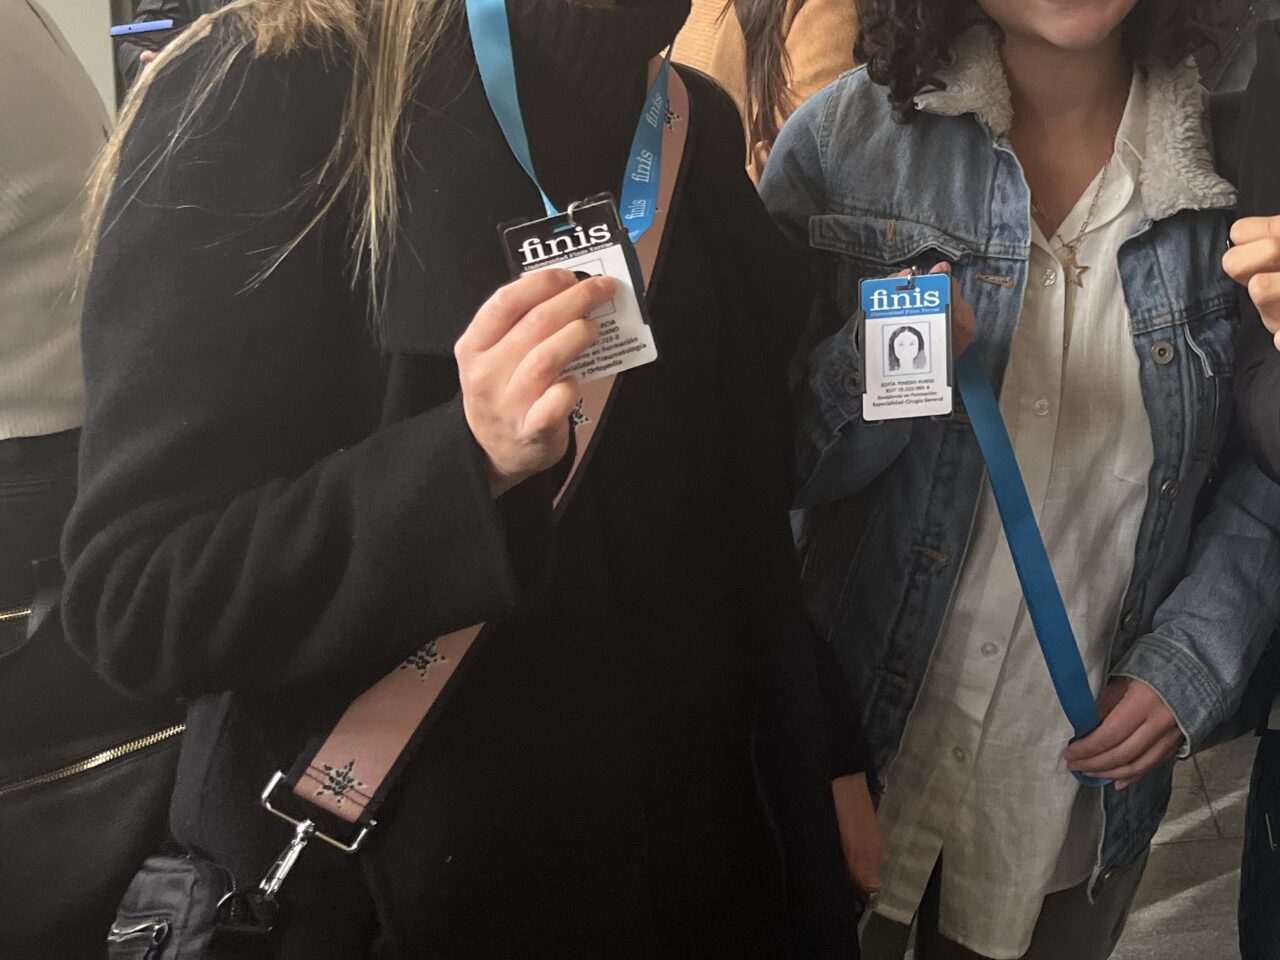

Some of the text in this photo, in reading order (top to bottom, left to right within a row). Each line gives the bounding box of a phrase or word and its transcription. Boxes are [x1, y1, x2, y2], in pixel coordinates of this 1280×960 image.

[645, 93, 663, 128] finis
[631, 149, 654, 183] finis
[625, 198, 647, 220] finis
[518, 224, 611, 265] finis
[870, 287, 940, 311] finis
